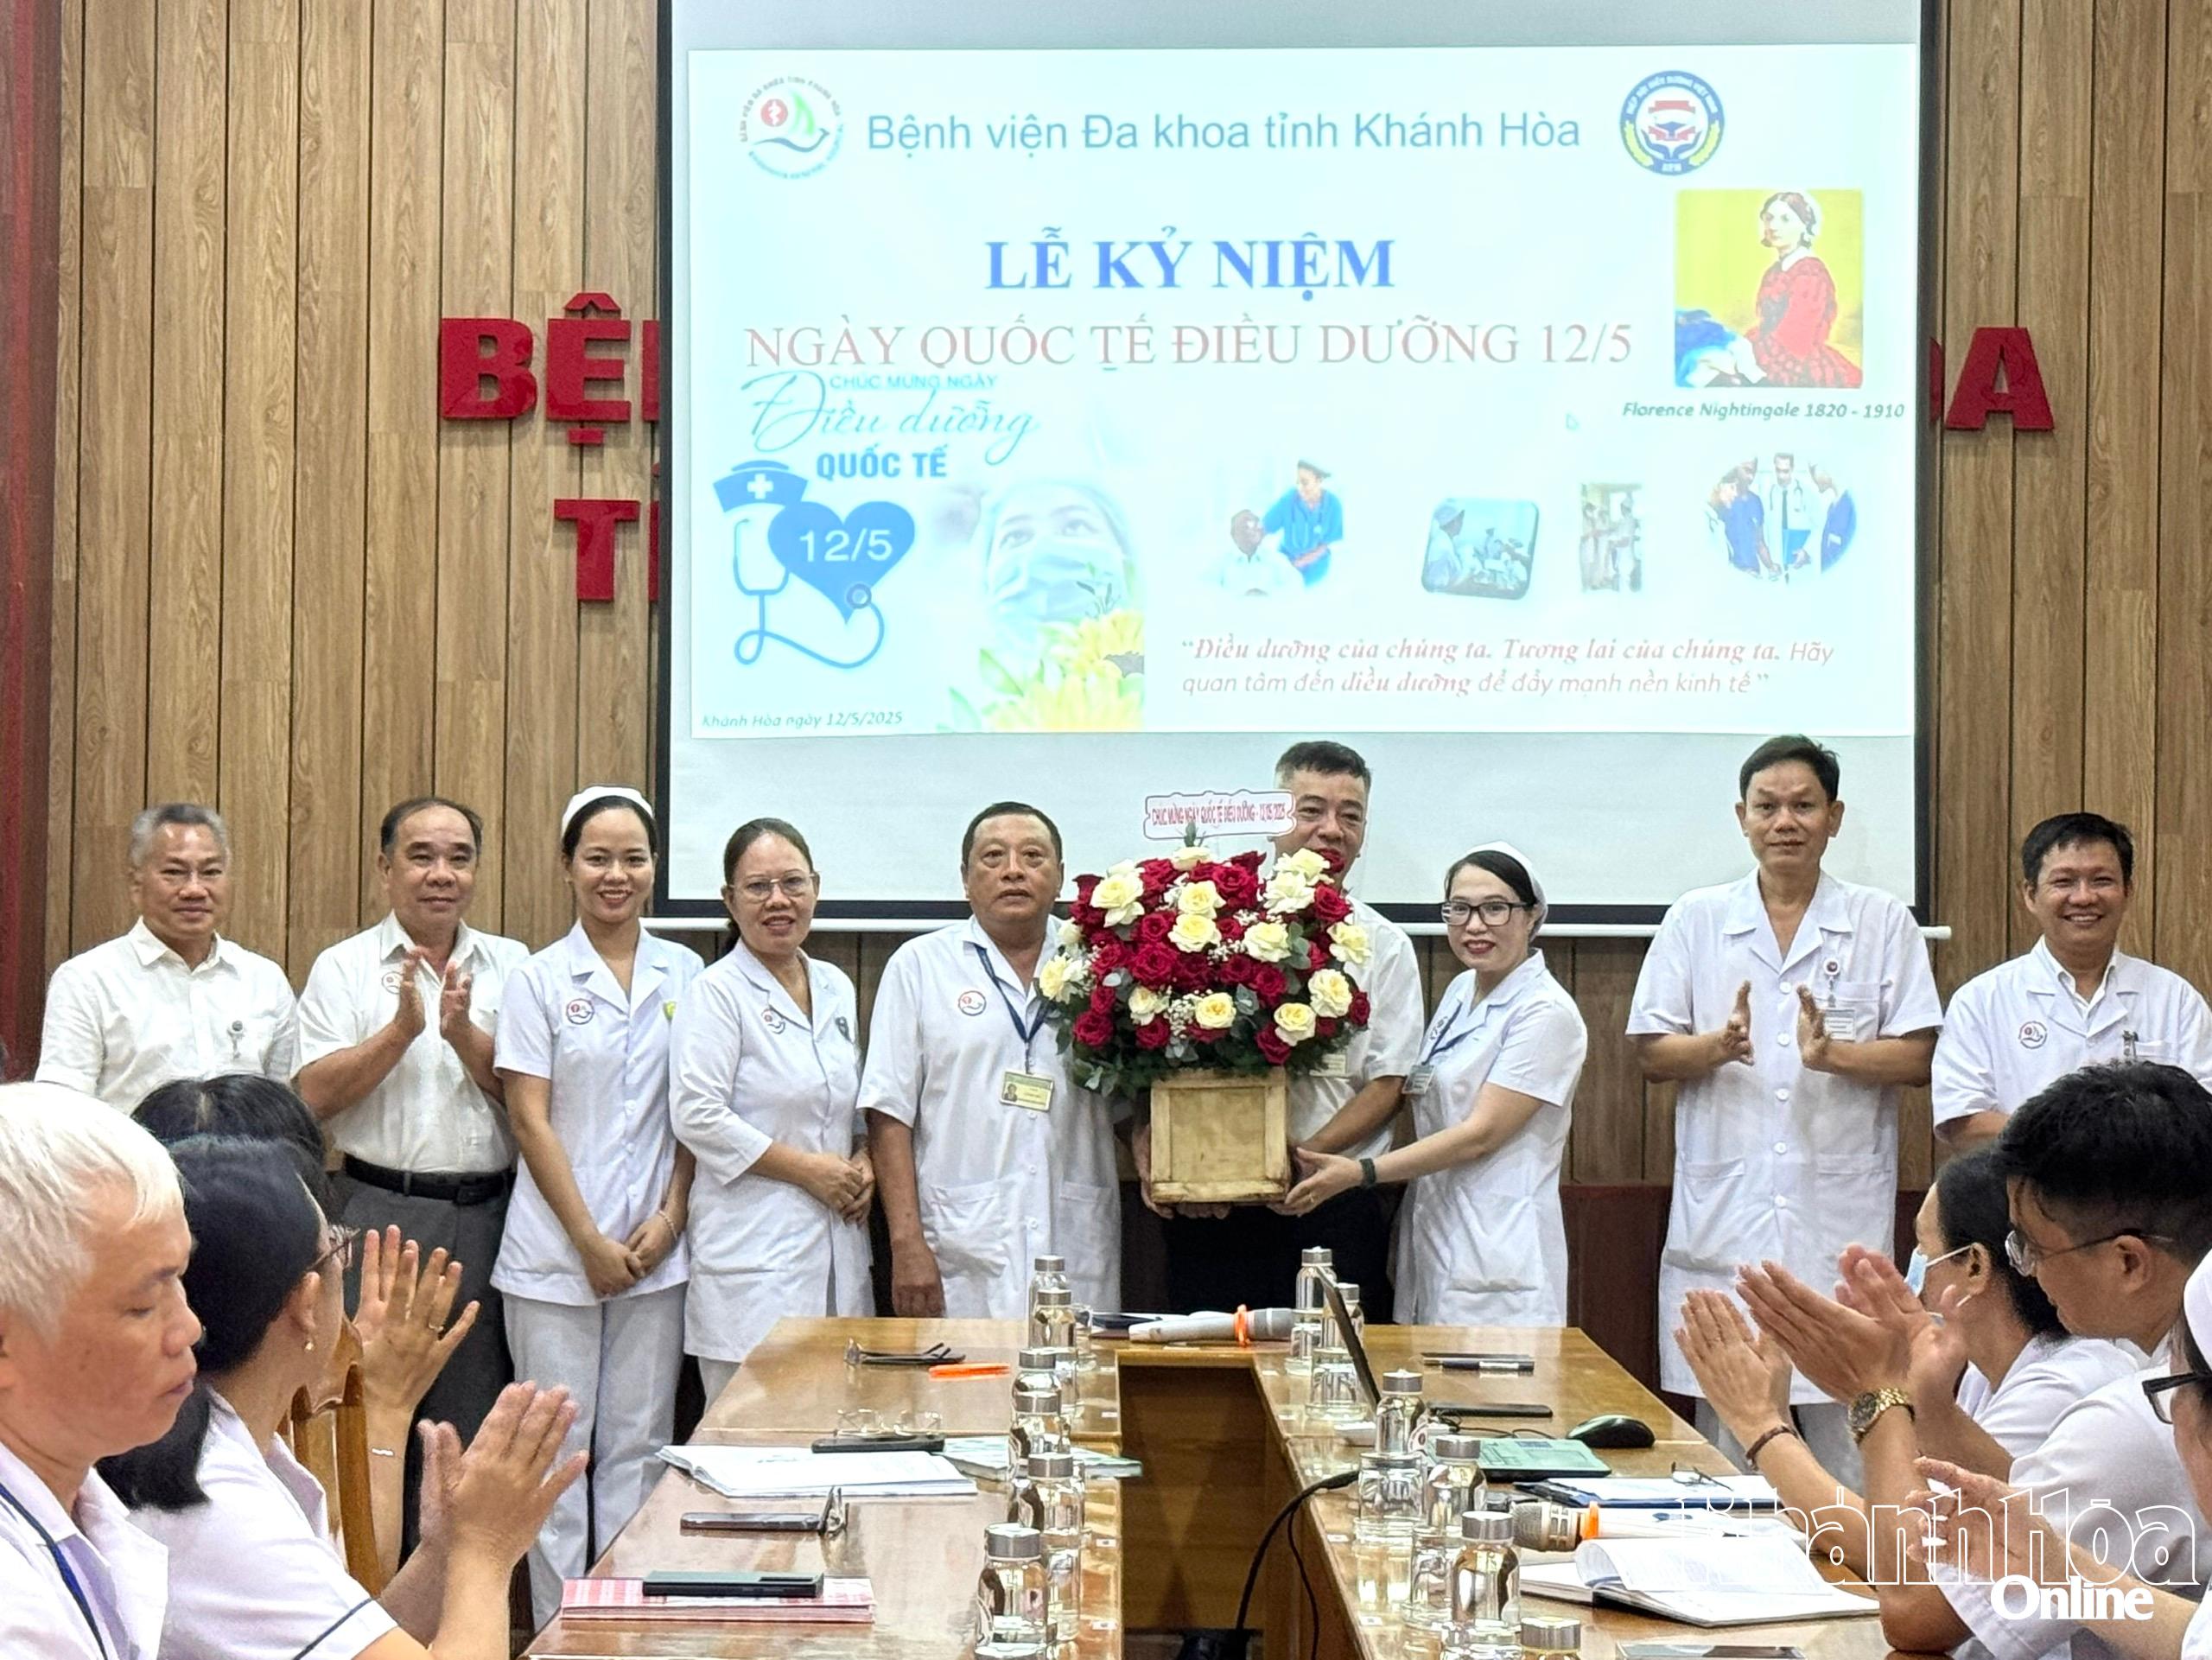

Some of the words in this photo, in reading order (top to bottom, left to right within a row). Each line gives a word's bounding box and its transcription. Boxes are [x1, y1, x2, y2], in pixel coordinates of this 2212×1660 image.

[868, 114, 970, 158] Bệnh
[987, 112, 1068, 158] viện
[1082, 114, 1138, 149] Đa
[1154, 113, 1249, 149] khoa
[1265, 111, 1338, 149] tỉnh
[1355, 111, 1483, 148] Khánh
[1501, 111, 1580, 147] Hòa
[986, 226, 1071, 289] LỄ
[1093, 226, 1192, 288] KỶ
[1212, 232, 1395, 302] NIỆM
[744, 314, 906, 367] NGÀY
[921, 313, 1076, 369] QUỐC
[1090, 313, 1156, 365] TẾ
[1171, 312, 1303, 364] ĐIỀU
[1318, 315, 1520, 365] DƯỠNG
[1542, 322, 1631, 364] 12/5
[1623, 402, 1694, 417] Florence
[1700, 402, 1800, 421] Nightingale
[1804, 404, 1847, 417] 1820
[1863, 404, 1904, 418] 1910
[817, 445, 900, 480] QUỐC
[912, 444, 948, 478] TẾ
[799, 529, 893, 562] 12/5
[1586, 637, 1618, 658] lai
[1673, 637, 1746, 665] chúng
[1789, 642, 1834, 666] Hãy
[1183, 678, 1236, 697] quan
[1245, 671, 1287, 692] tâm
[1294, 669, 1334, 691] đến
[1478, 667, 1507, 692] để
[1511, 669, 1554, 696] đẩy
[1559, 673, 1621, 697] mạnh
[1628, 668, 1668, 692] nền
[1676, 673, 1720, 693] kinh
[702, 715, 747, 727] Khánh
[753, 714, 781, 726] Hòa
[786, 714, 822, 728] ngày
[827, 711, 902, 726] 12/5/2025
